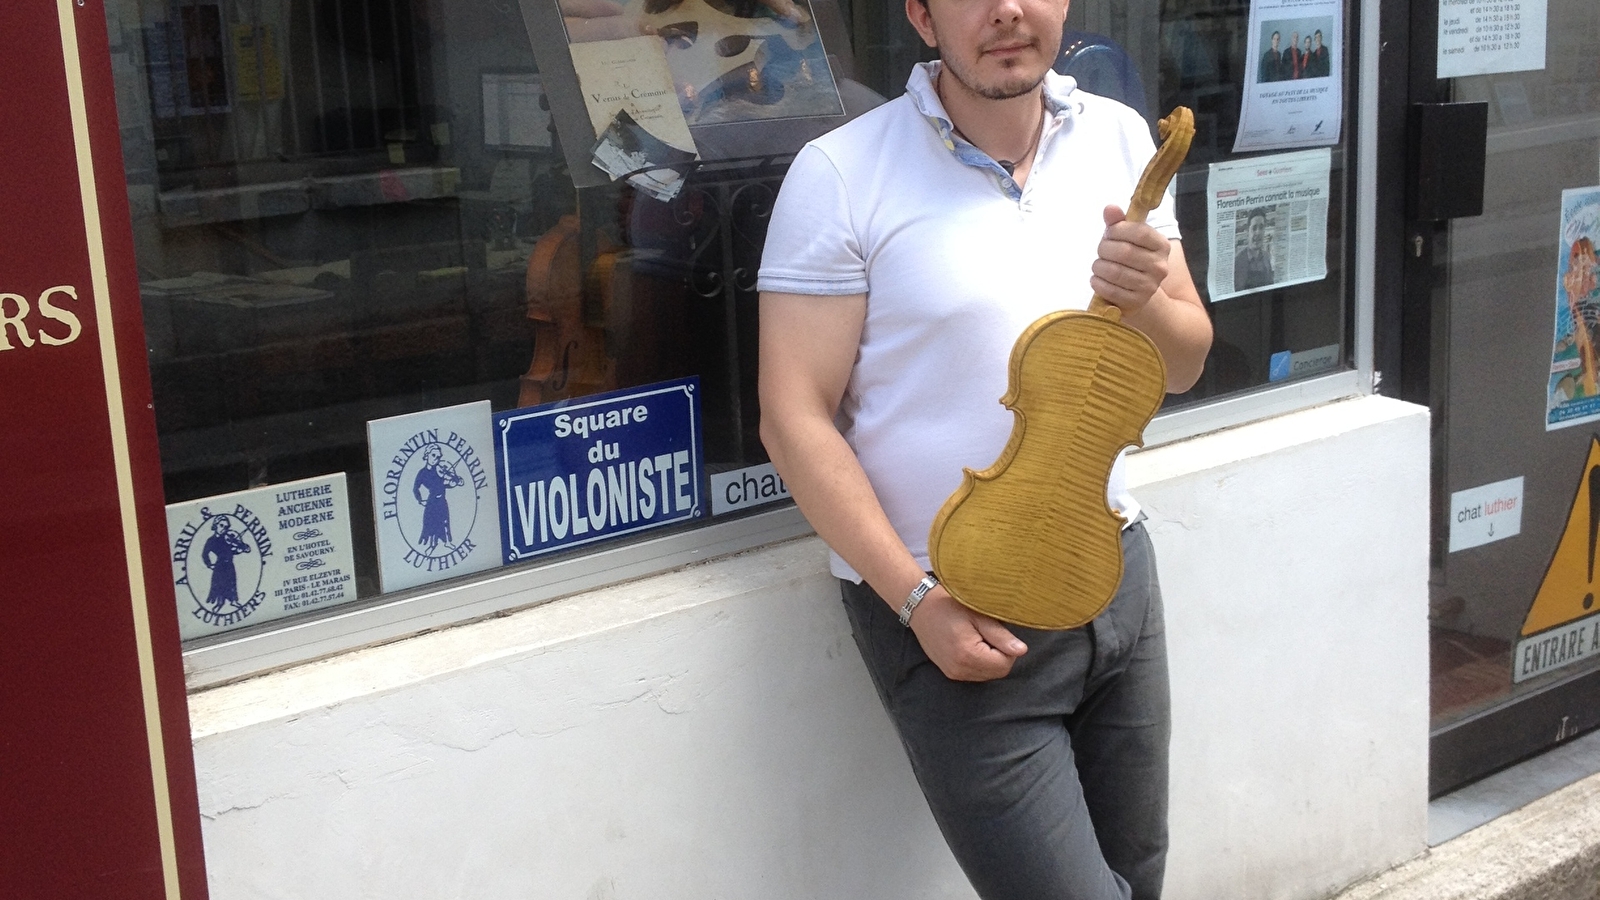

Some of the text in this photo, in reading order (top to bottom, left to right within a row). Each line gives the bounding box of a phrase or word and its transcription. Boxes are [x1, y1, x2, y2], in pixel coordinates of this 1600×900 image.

[1217, 197, 1244, 209] Florentin
[1246, 194, 1264, 205] Perrin
[1295, 188, 1320, 198] musique
[555, 405, 648, 438] Square
[588, 440, 620, 463] du
[383, 428, 439, 520] FLORENTIN
[276, 484, 332, 503] LUTHERIE
[515, 450, 691, 546] VIOLONISTE
[200, 506, 214, 521] &
[278, 498, 333, 516] ANCIENNE
[1458, 495, 1518, 523] chat luthier
[279, 511, 334, 530] MODERNE
[296, 546, 335, 560] SAVOURNY
[403, 538, 476, 572] LUTHIER
[285, 584, 306, 594] PARIS
[322, 575, 351, 586] MARAIS
[293, 576, 308, 584] RUE
[309, 569, 341, 581] ELZEVIR
[192, 590, 266, 626] LUTHIERS
[1522, 627, 1586, 675] ENTRARE
